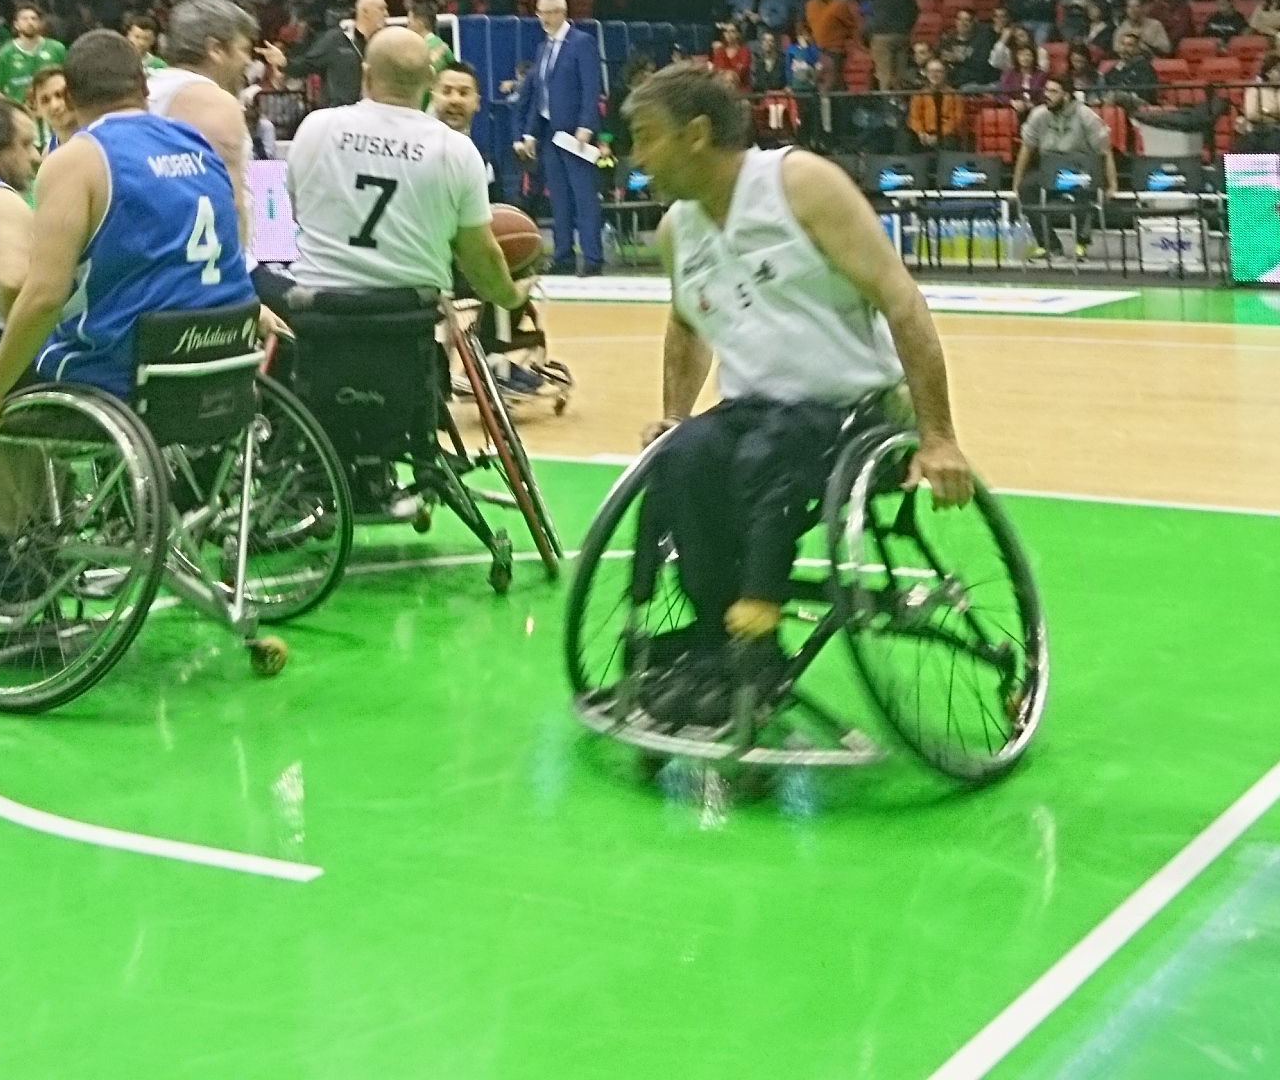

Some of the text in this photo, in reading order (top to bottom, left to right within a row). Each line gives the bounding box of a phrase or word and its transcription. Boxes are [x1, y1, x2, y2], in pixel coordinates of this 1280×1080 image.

[338, 131, 426, 162] PUSKAS
[186, 195, 222, 285] 4
[348, 173, 398, 249] 7
